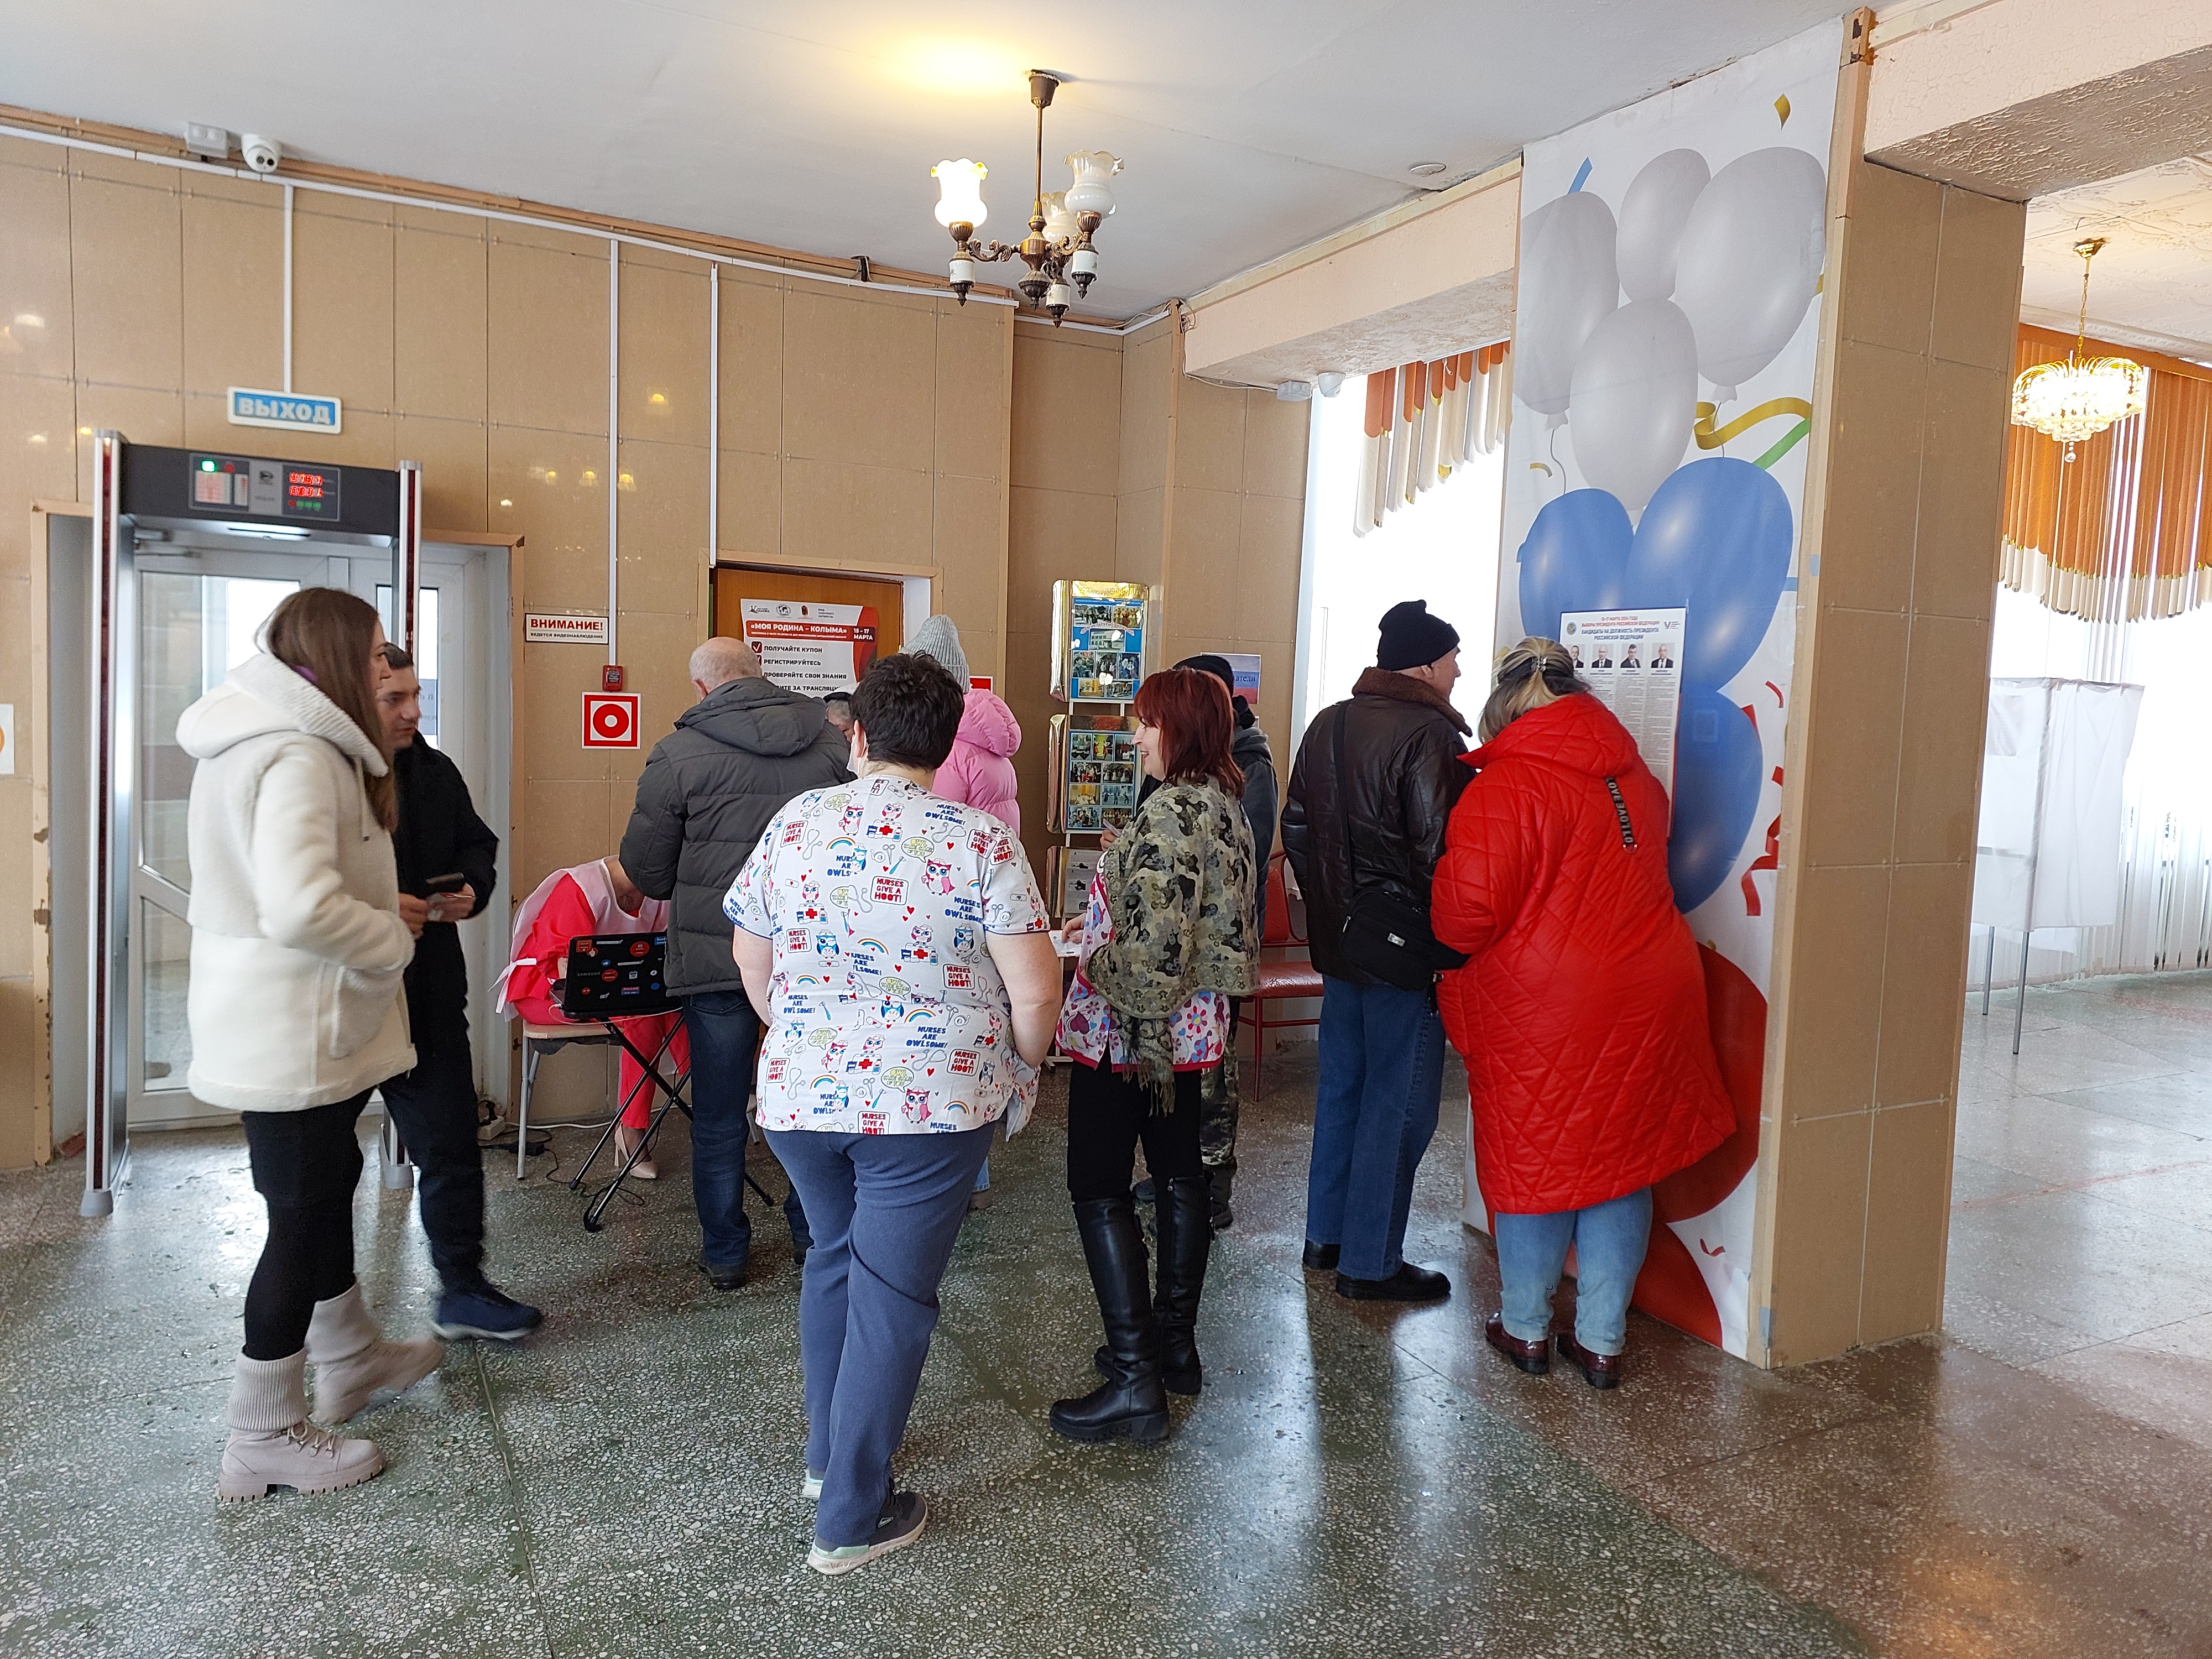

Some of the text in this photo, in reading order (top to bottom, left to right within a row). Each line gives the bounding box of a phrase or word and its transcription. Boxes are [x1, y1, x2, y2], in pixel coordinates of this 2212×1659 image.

[238, 398, 331, 425] ВЫХОД
[530, 619, 603, 630] ВНИМАНИЕ!
[773, 623, 804, 632] РОДИНА
[937, 804, 963, 814] NURSES
[925, 812, 966, 825] OWLSOME!
[782, 834, 801, 845] HOOT!
[877, 878, 904, 887] NURSES
[874, 891, 902, 902] HOOT!
[954, 896, 981, 909] NURSES
[959, 904, 973, 913] ARE
[945, 909, 983, 924] OWLSOME
[790, 943, 808, 951] HOOT!
[948, 979, 972, 988] HOOT!
[917, 1026, 947, 1034] NURSES
[906, 1039, 948, 1048] OWLSOME!
[954, 1051, 977, 1060] NURSES
[950, 1063, 974, 1074] HOOT!
[767, 1073, 784, 1081] HOOT!
[930, 1121, 957, 1131] NURSES
